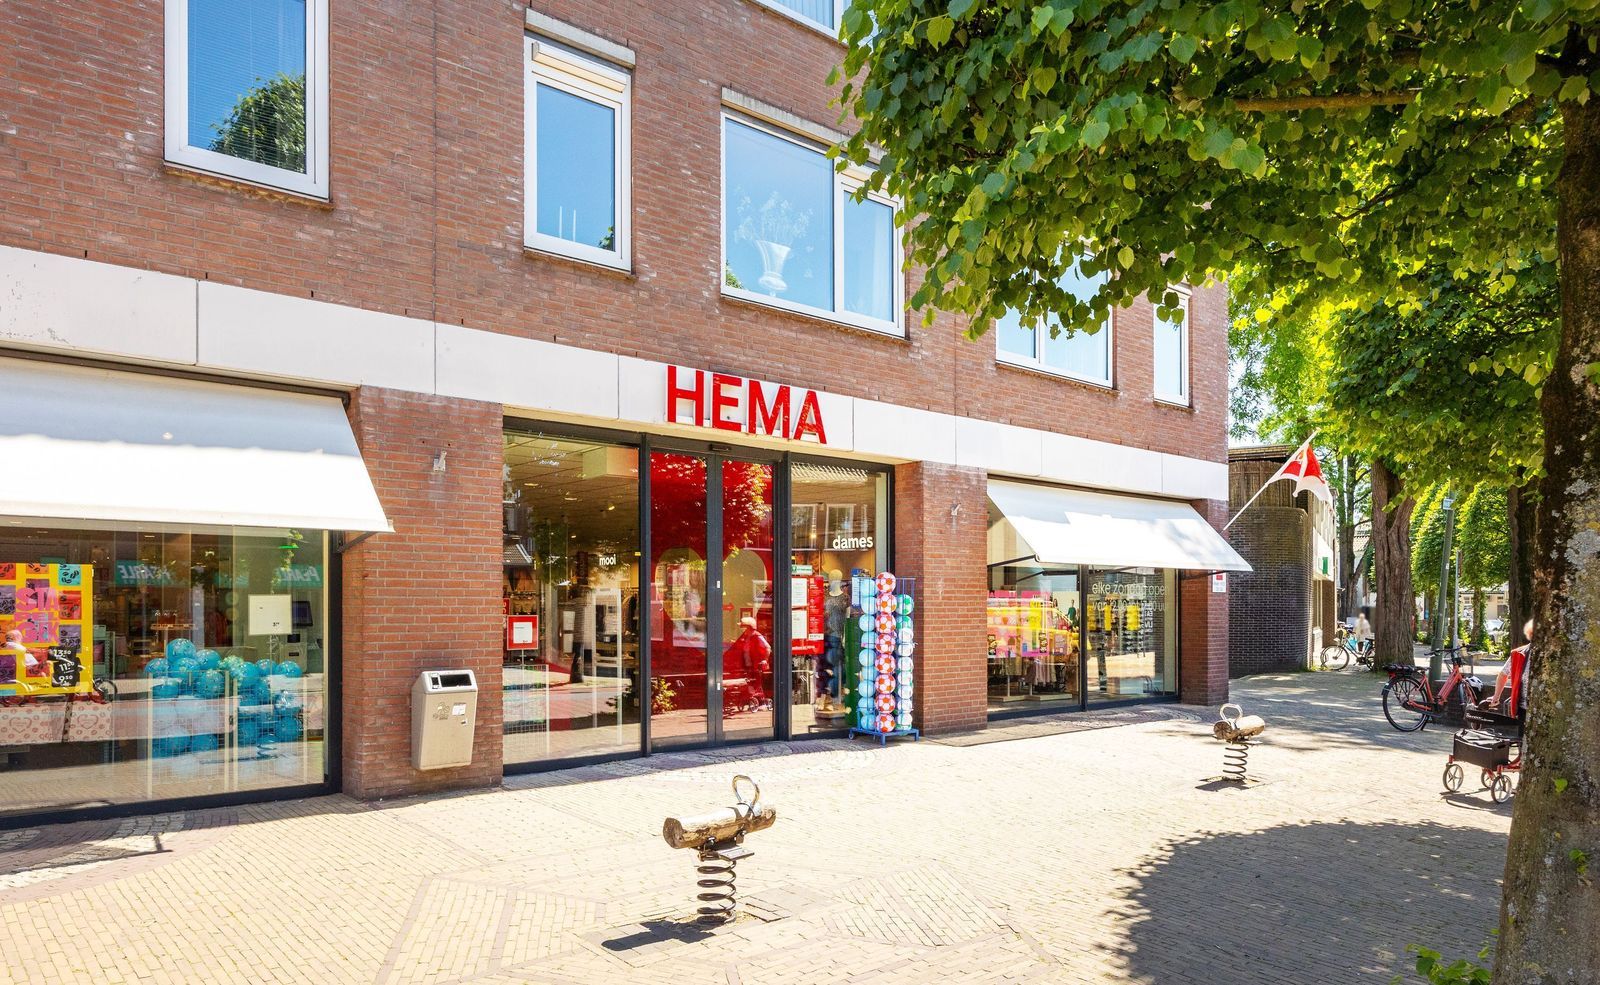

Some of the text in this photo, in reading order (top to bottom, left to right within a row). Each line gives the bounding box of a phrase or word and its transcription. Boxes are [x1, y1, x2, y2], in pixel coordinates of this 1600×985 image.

[667, 364, 827, 445] HEMA
[832, 535, 873, 550] dames
[599, 553, 617, 566] mooi
[1092, 581, 1111, 595] elke
[16, 587, 59, 611] STA
